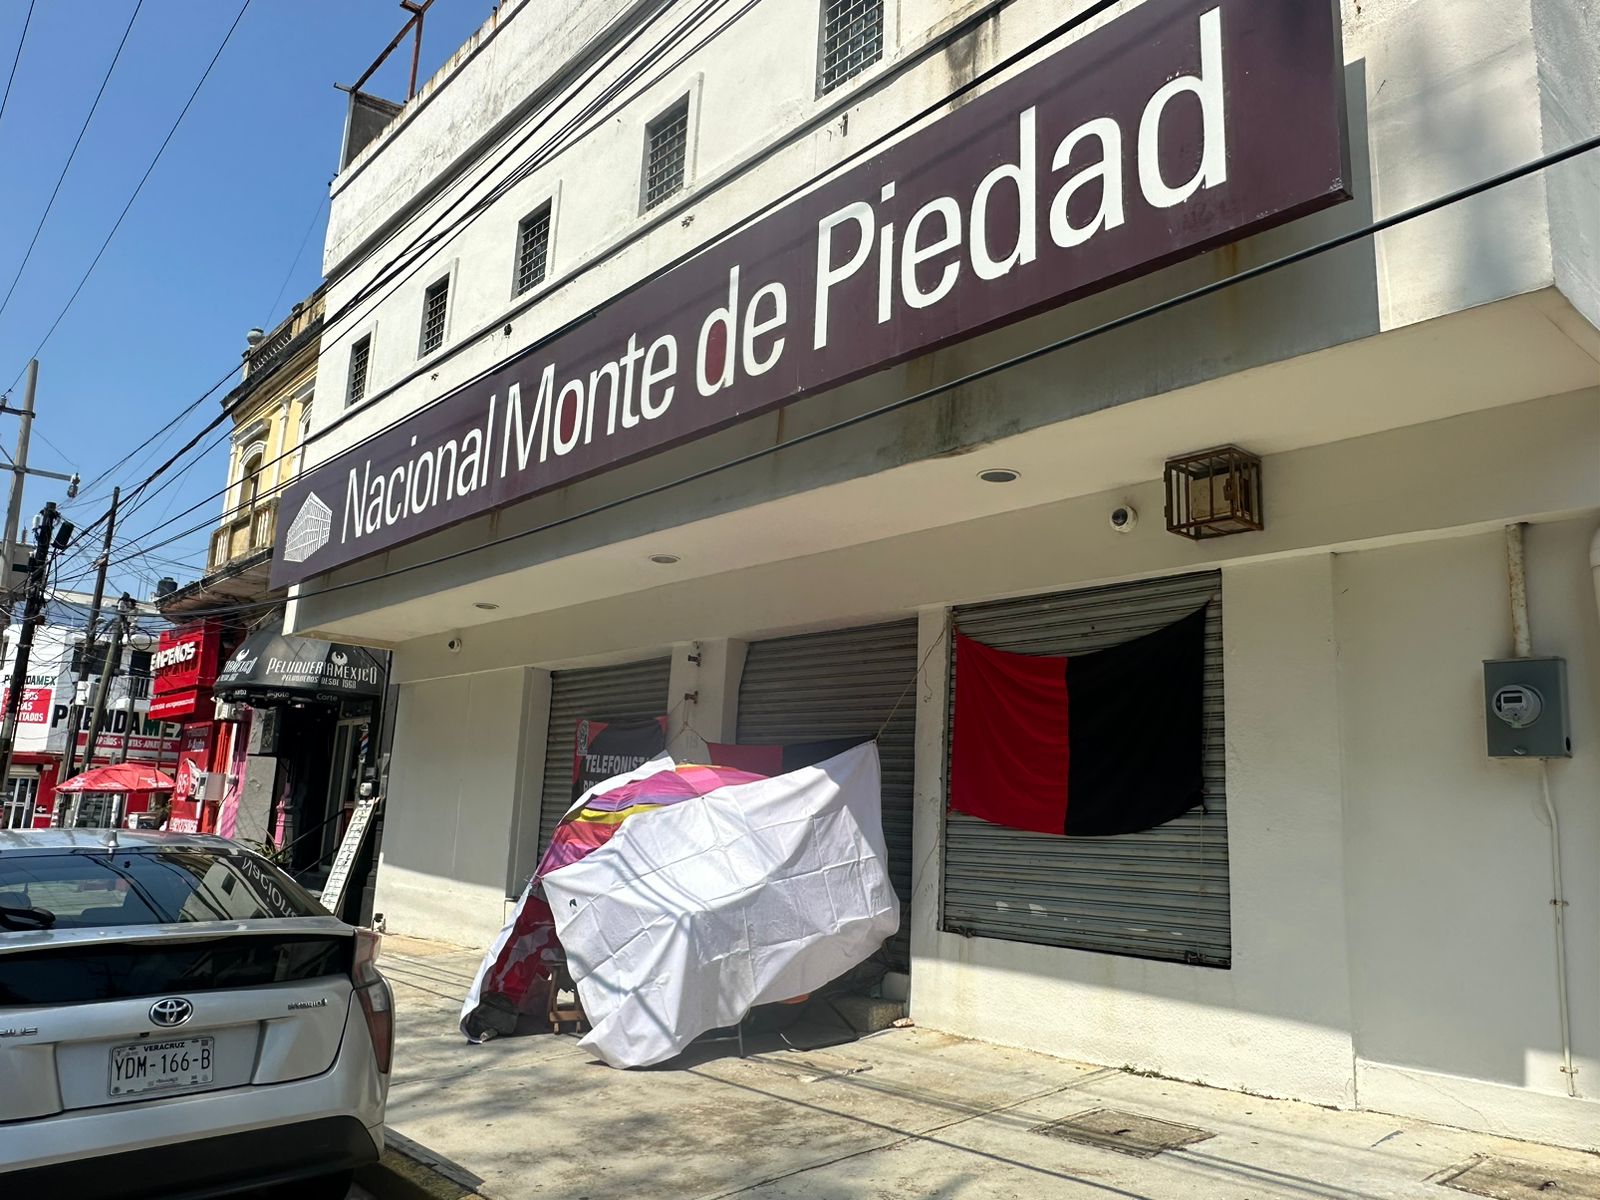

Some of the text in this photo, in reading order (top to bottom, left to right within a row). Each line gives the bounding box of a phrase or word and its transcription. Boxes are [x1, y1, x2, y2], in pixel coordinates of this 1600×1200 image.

[340, 6, 1228, 544] Nacional Monte de Piedad
[143, 1042, 185, 1052] VERACRUZ
[115, 1048, 211, 1081] YDM-166-B
